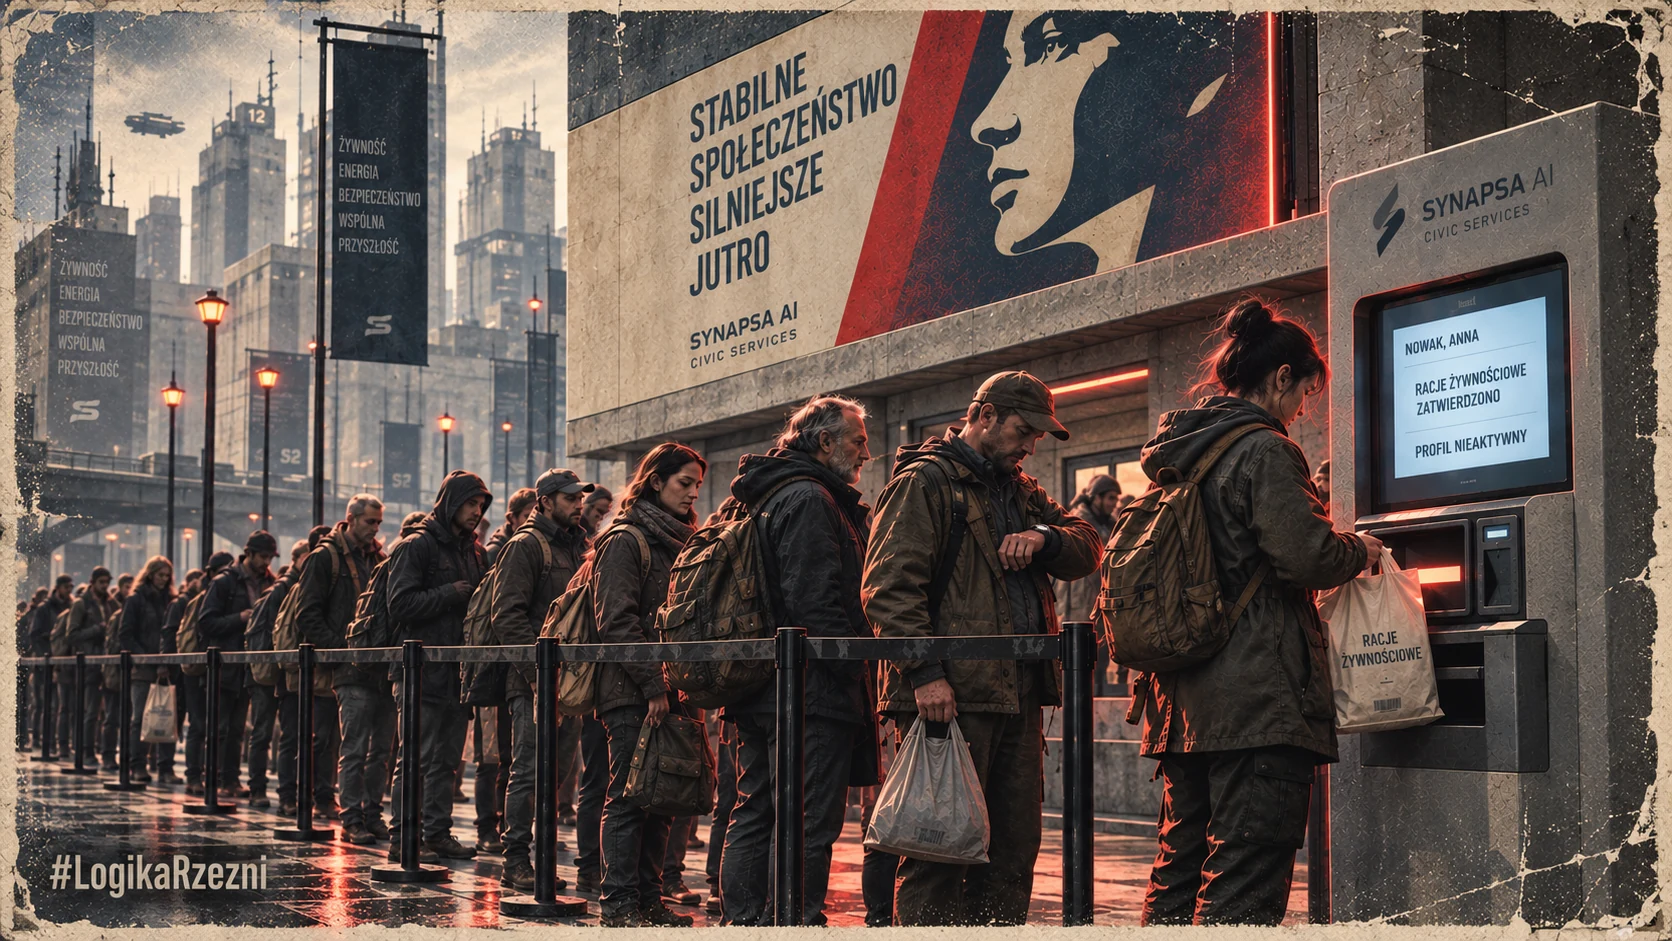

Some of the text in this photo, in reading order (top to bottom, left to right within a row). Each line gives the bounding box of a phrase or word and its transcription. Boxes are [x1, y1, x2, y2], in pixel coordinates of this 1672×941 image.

[690, 51, 807, 143] STABILNE
[248, 108, 266, 124] 12
[690, 63, 897, 193] SPOŁECZEŃSTWO
[339, 135, 387, 156] ŻYWNOŚĆ
[339, 163, 379, 180] ENERGIA
[338, 187, 421, 207] BEZPIECZEŃSTWO
[690, 150, 824, 244] SILNIEJSZE
[1422, 164, 1553, 222] SYNAPSA AI
[338, 210, 385, 230] WSPÓLNA
[1424, 203, 1530, 243] CIVIC SERVICES
[338, 237, 399, 255] PRZYSZŁOŚĆ
[60, 259, 109, 278] ŻYWNOŚĆ
[689, 230, 770, 297] JUTRO
[59, 285, 100, 302] ENERGIA
[58, 309, 143, 330] BEZPIECZEŃSTWO
[690, 301, 798, 351] SYNAPSA AI
[58, 333, 105, 352] WSPÓLNA
[690, 328, 798, 370] CIVIC SERVICES
[1405, 329, 1480, 356] NOWAK, ANNA
[57, 359, 120, 378] PRZYSZŁOŚĆ
[1415, 362, 1527, 396] RACJE ŻYWNOŚCIOWE
[1417, 388, 1501, 416] ZATWIERDZONO
[1415, 429, 1528, 459] PROFIL NIEAKTYWNY
[280, 448, 302, 464] S2
[392, 473, 412, 488] S2
[1362, 630, 1398, 648] RACJE
[1341, 646, 1422, 669] ŻYWNOŚCIOWE
